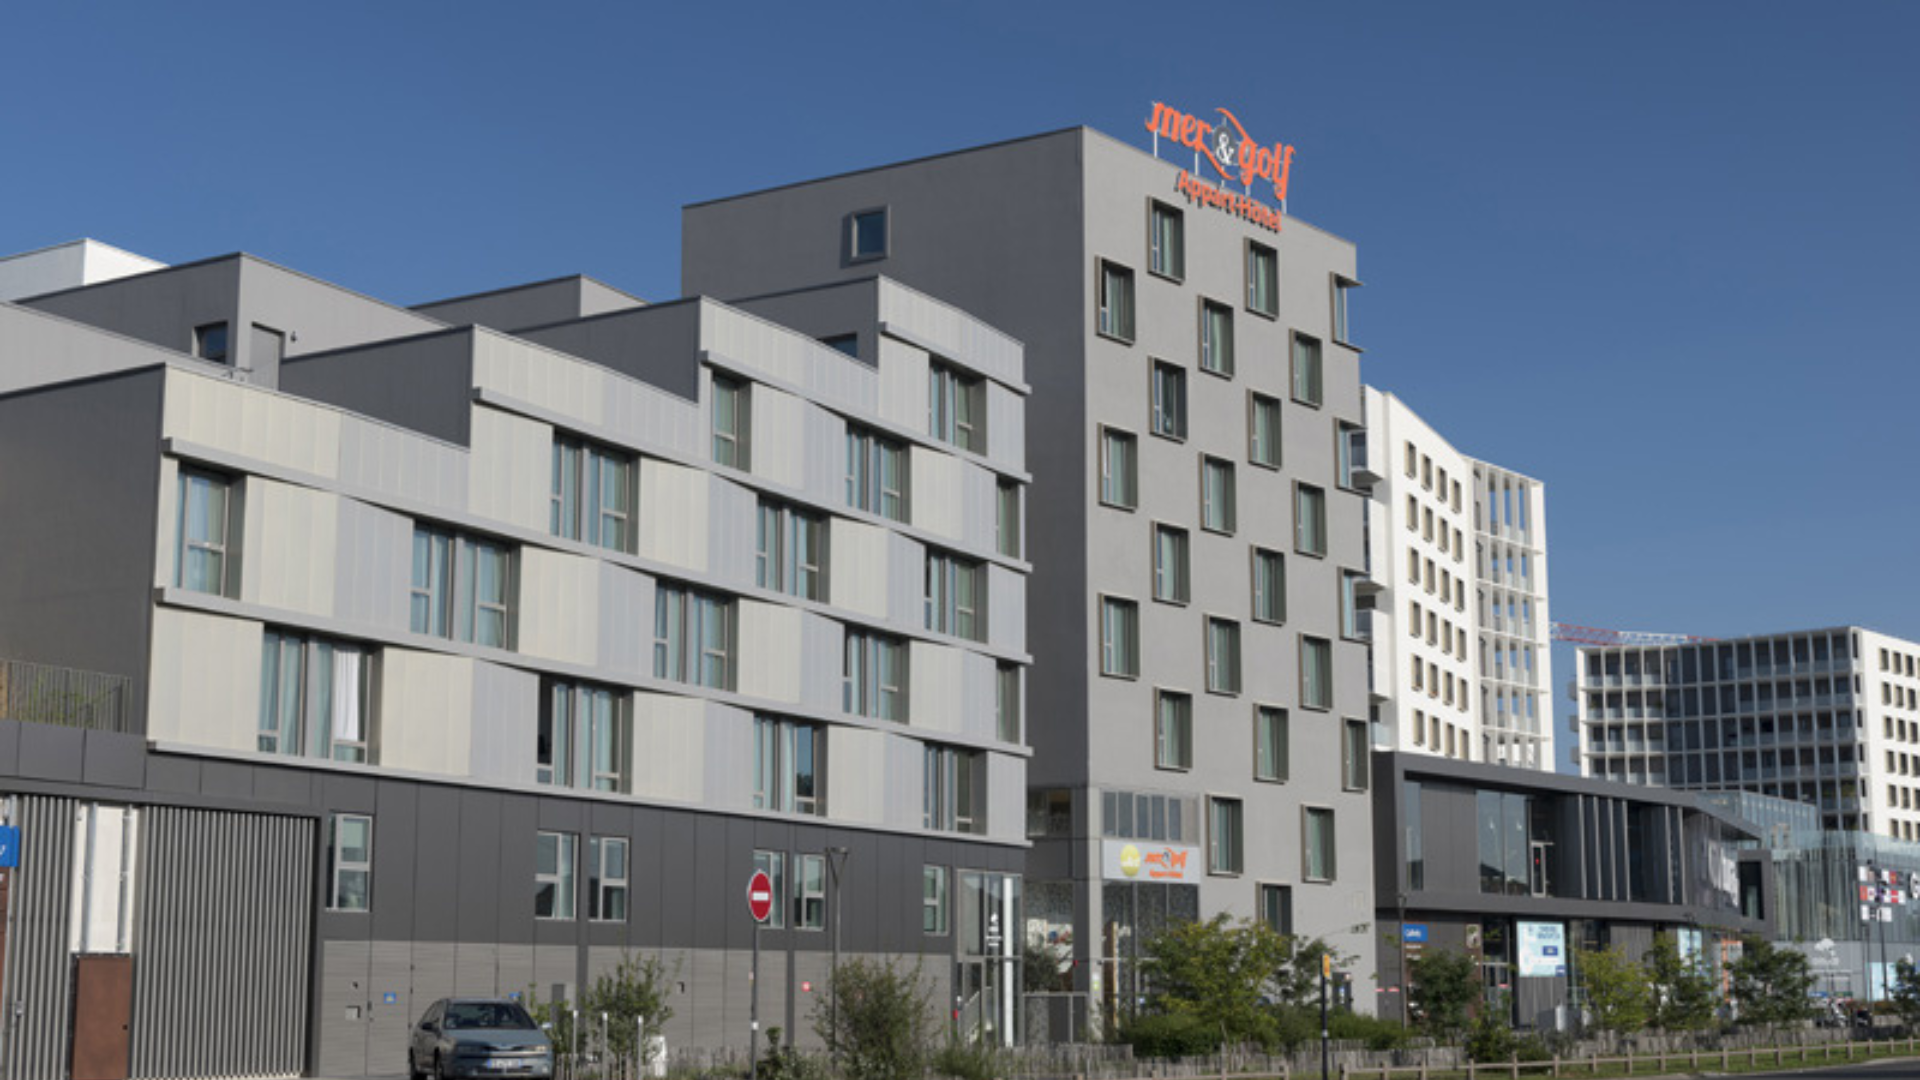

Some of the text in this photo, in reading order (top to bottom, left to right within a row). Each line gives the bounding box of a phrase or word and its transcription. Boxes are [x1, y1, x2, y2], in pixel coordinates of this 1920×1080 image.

[1145, 102, 1296, 201] mer & golf
